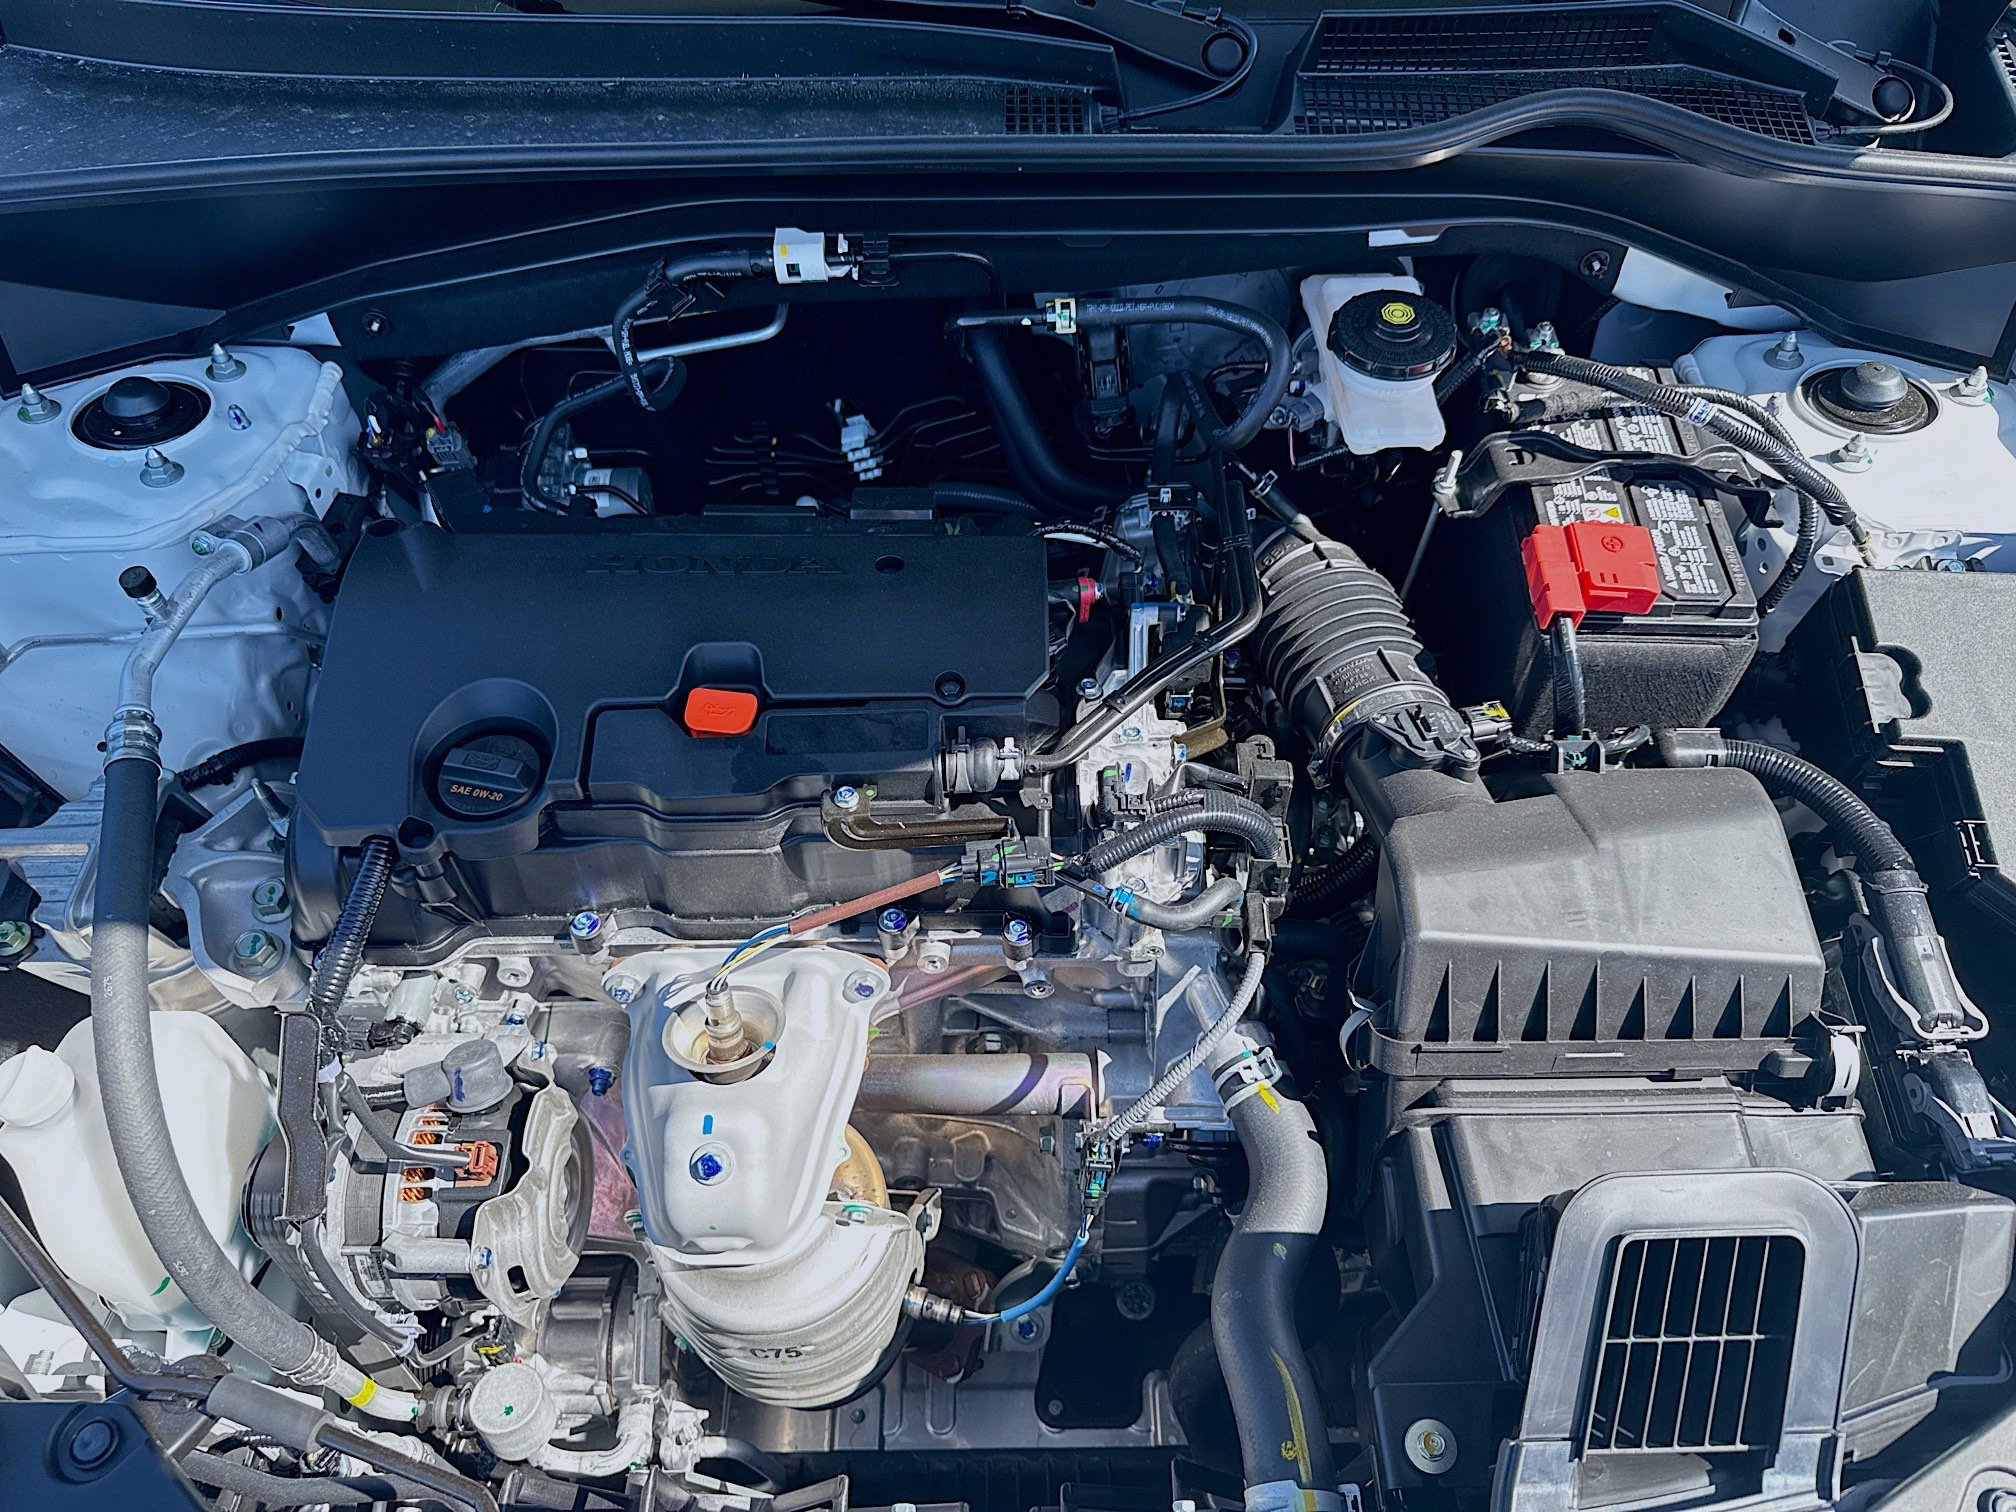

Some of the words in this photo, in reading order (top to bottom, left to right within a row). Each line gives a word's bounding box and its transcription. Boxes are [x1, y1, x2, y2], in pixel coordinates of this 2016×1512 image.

[584, 554, 844, 575] HONDA
[1330, 657, 1374, 678] HONDA
[450, 783, 472, 795] SAE
[473, 787, 504, 802] 0W-20
[749, 1345, 804, 1359] C75
